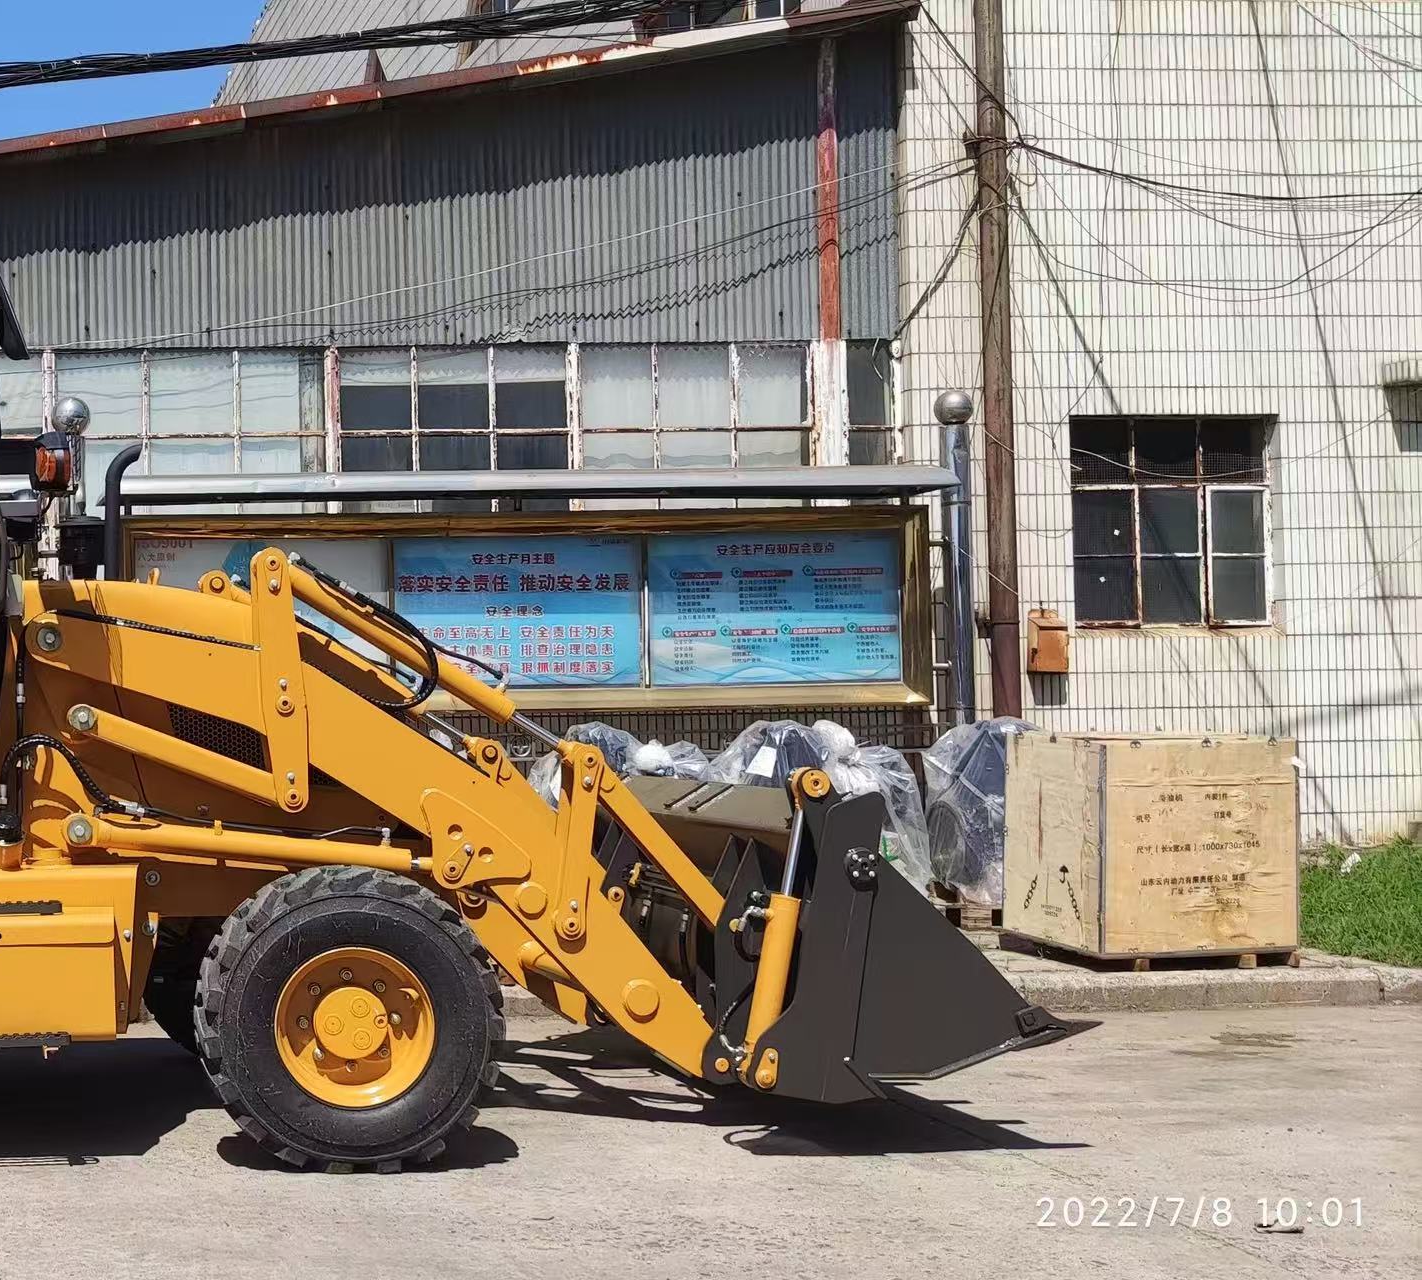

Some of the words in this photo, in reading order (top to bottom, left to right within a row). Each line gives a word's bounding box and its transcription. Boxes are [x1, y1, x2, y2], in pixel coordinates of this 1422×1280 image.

[471, 553, 555, 565] 安全生产月主题
[398, 575, 510, 593] 落实安全责任
[519, 573, 630, 592] 推动安全发展
[485, 605, 545, 617] 安全理念
[520, 626, 615, 638] 安全责任为天
[520, 644, 615, 656] 排查治理隐患
[521, 661, 614, 675] 狠抓制度落实
